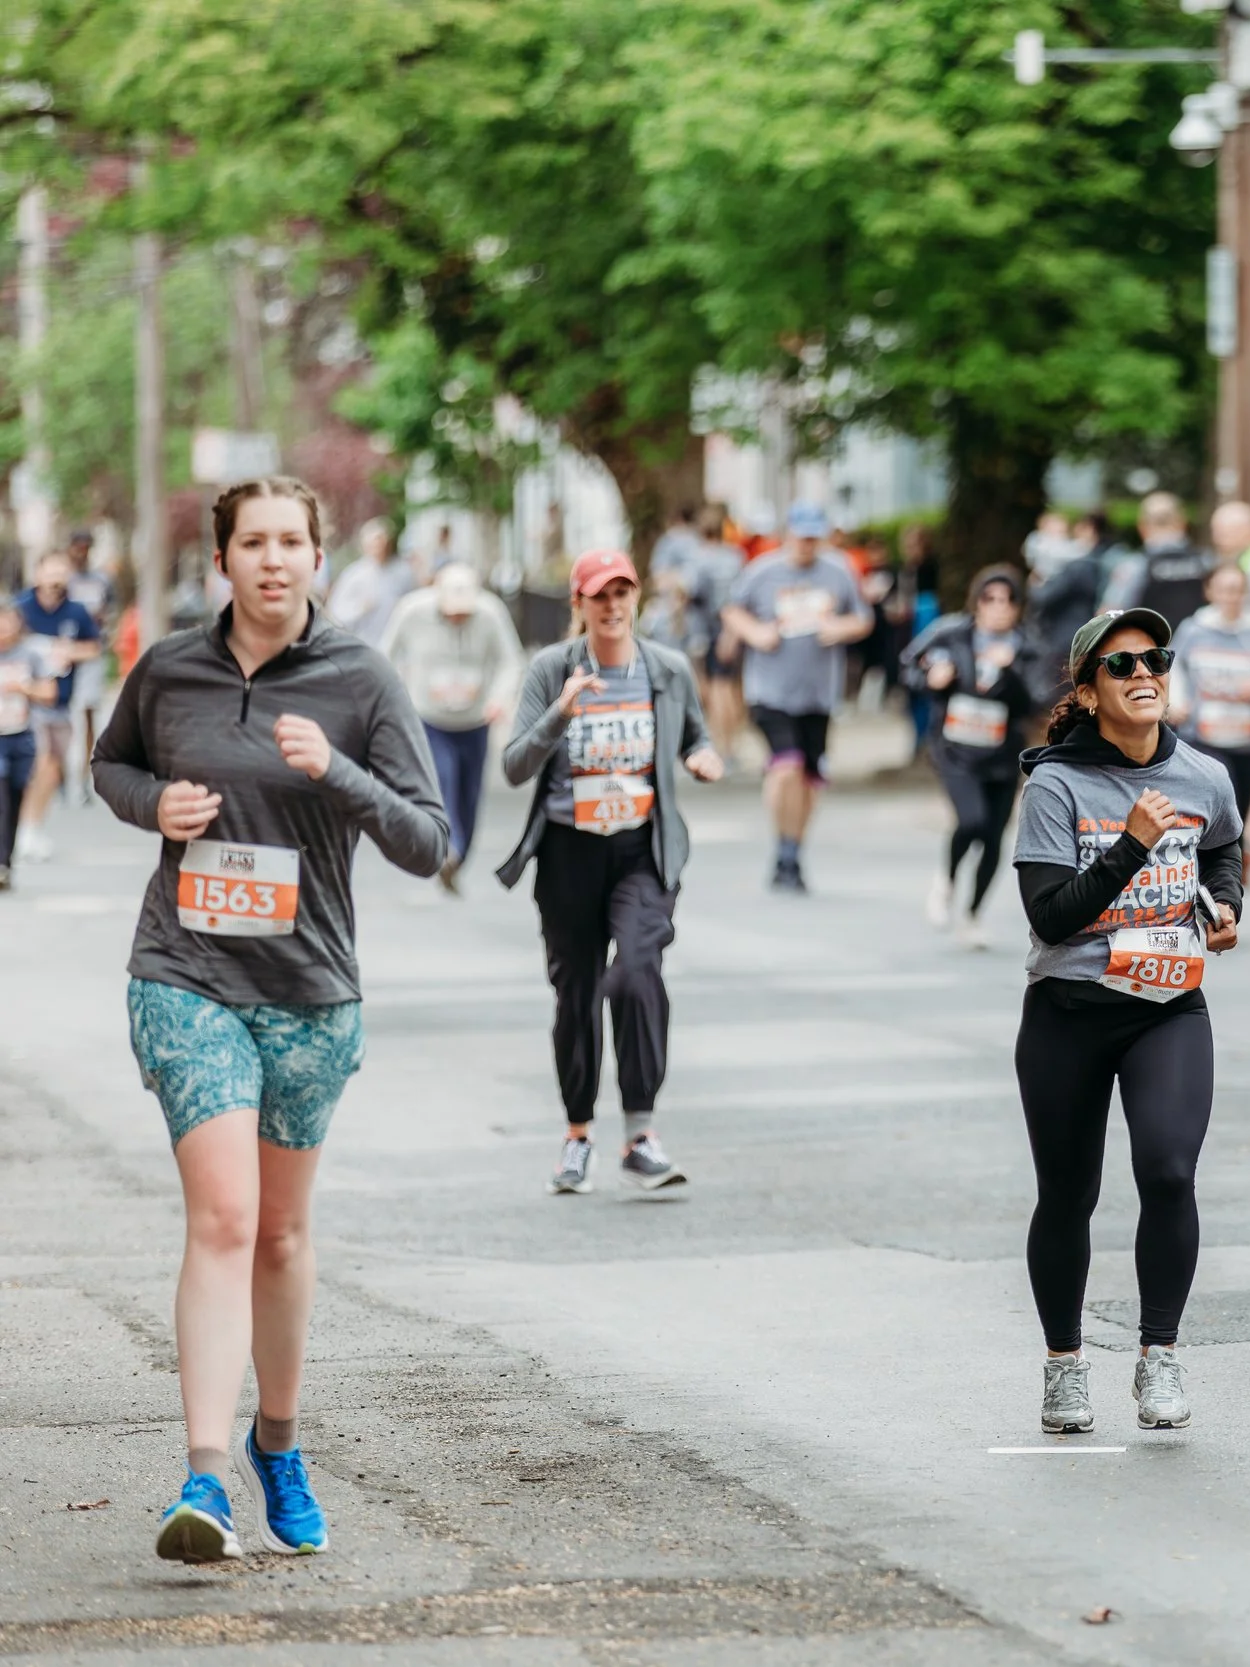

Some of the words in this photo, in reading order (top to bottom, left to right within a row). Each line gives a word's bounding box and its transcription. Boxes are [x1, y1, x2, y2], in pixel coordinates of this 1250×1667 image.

[1099, 818, 1127, 831] Yea
[194, 877, 277, 915] 1563
[1108, 879, 1197, 910] ACISM
[1098, 909, 1127, 923] RIL
[1127, 956, 1188, 986] 1818
